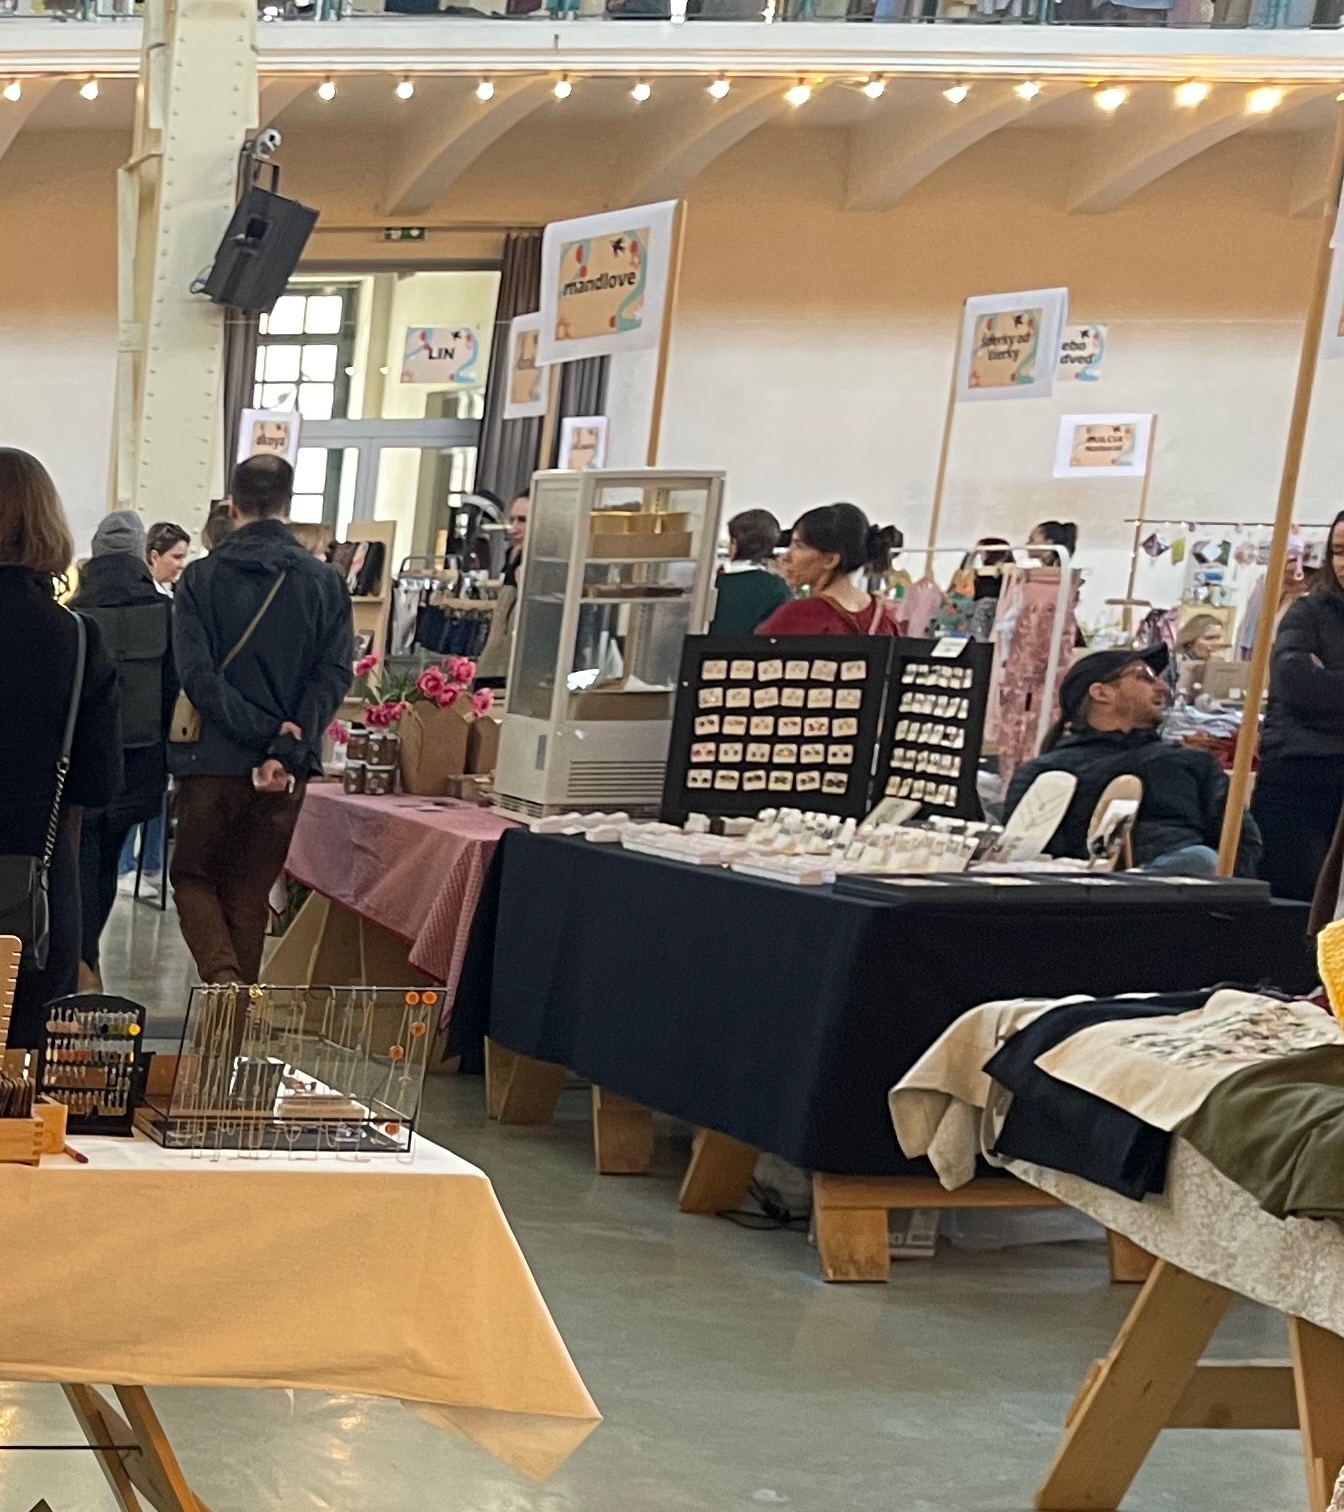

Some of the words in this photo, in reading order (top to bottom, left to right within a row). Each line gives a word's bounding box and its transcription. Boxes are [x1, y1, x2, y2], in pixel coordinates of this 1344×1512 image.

[562, 272, 636, 296] mandlove
[1061, 340, 1086, 351] ebo
[428, 348, 456, 360] LIN
